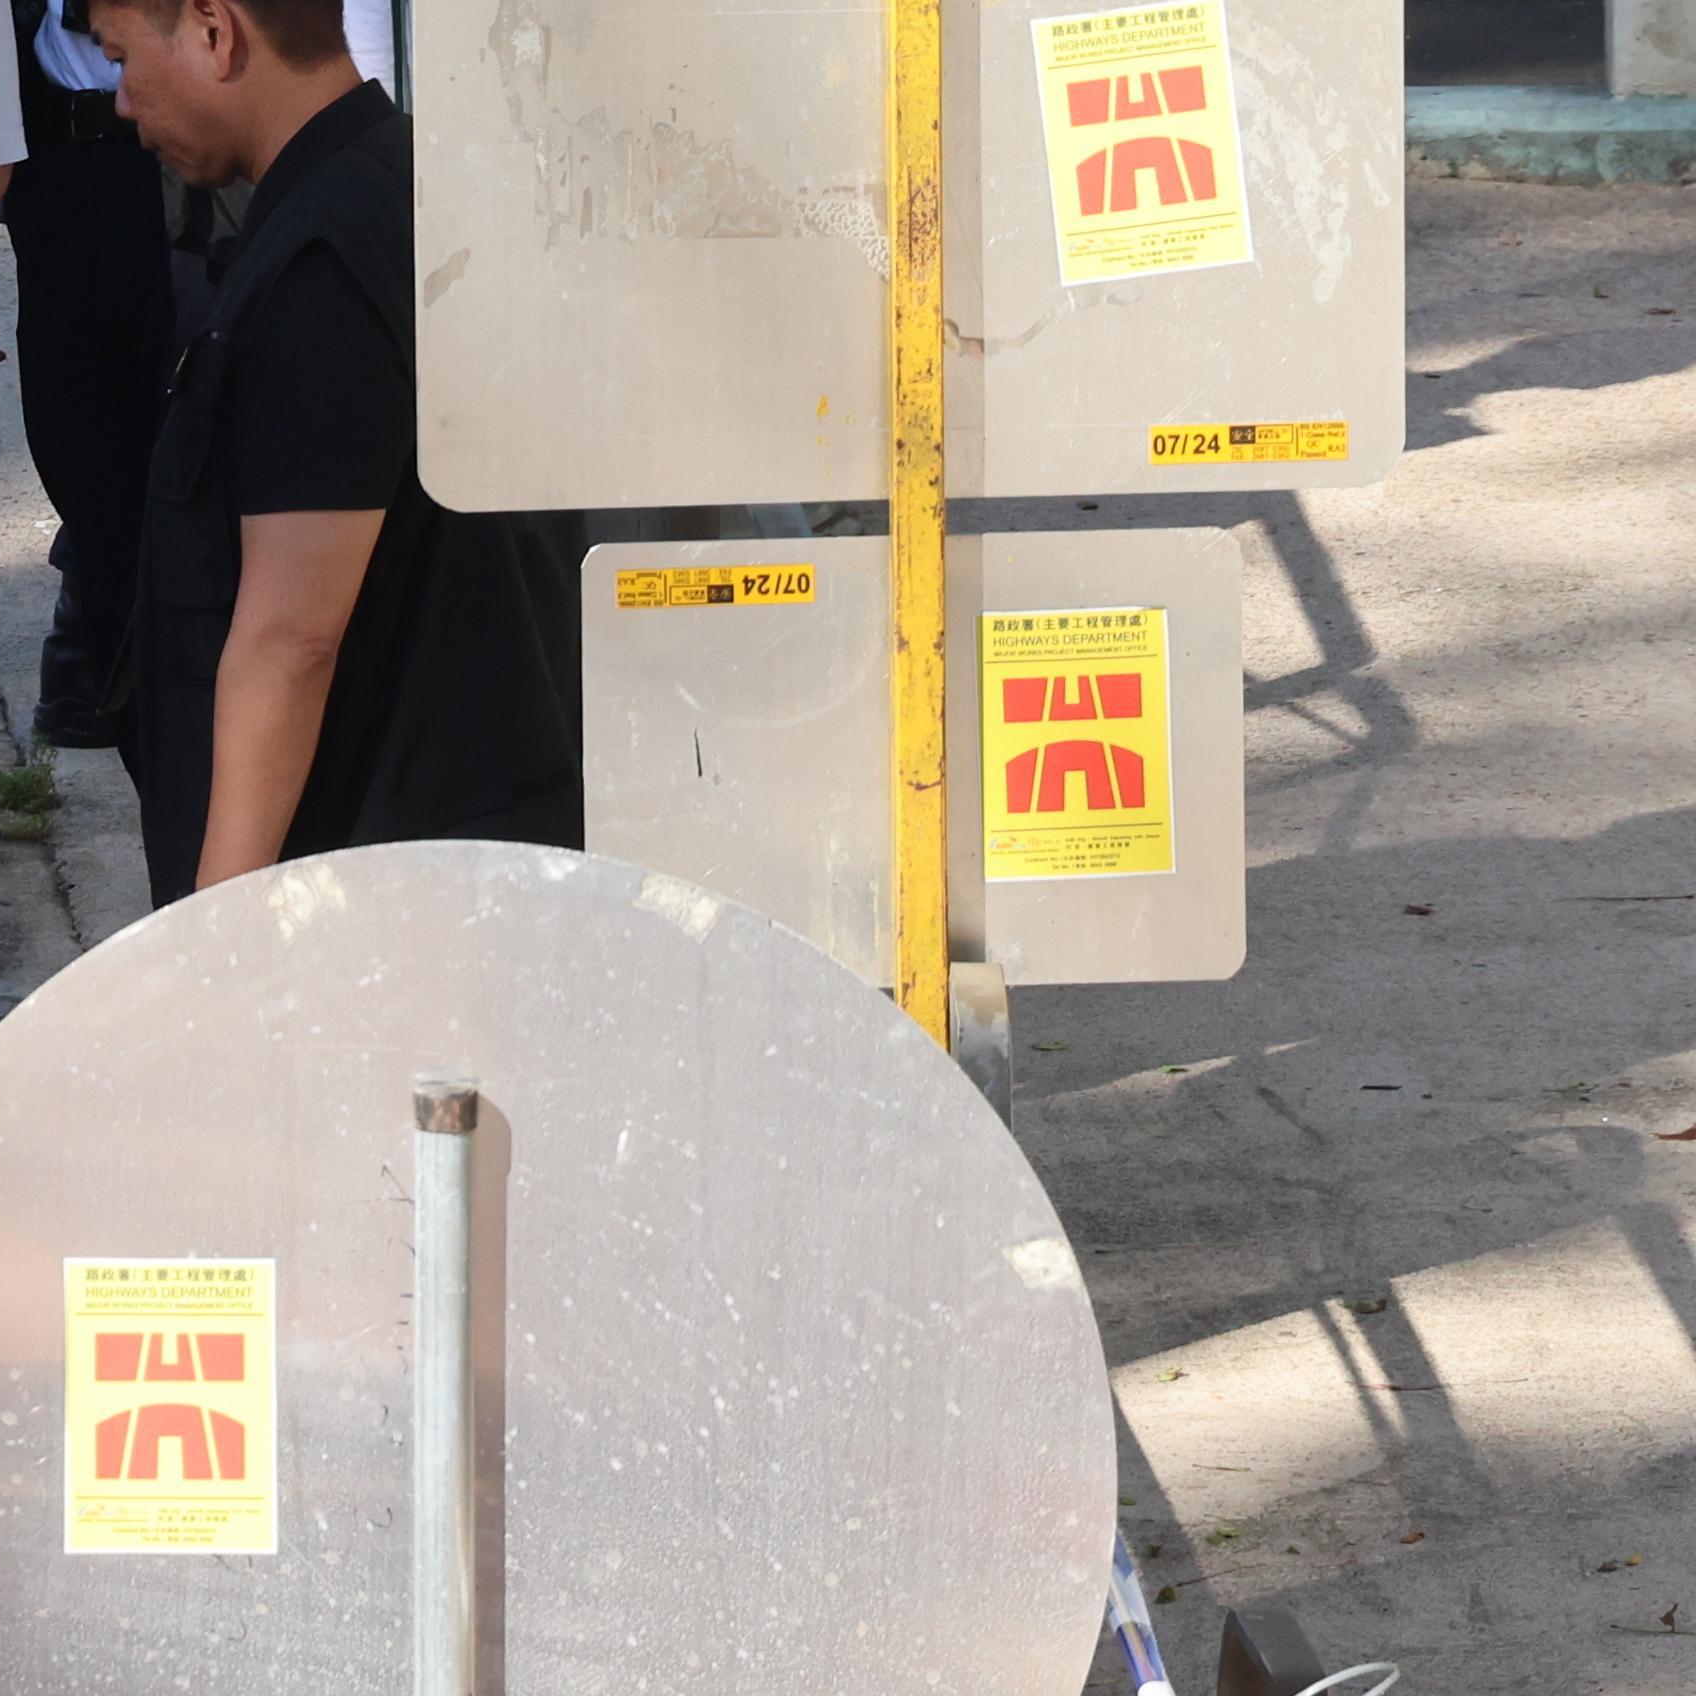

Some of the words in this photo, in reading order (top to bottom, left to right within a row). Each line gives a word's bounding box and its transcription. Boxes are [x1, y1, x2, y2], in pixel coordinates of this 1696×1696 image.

[1054, 33, 1119, 53] HIGHWAYS
[1122, 21, 1206, 44] DEPARTMENT
[993, 634, 1059, 647] HIGHWAYS
[1063, 631, 1148, 645] DEPARTMENT
[85, 1286, 157, 1298] HIGHWAYS
[161, 1286, 253, 1298] DEPARTMENT
